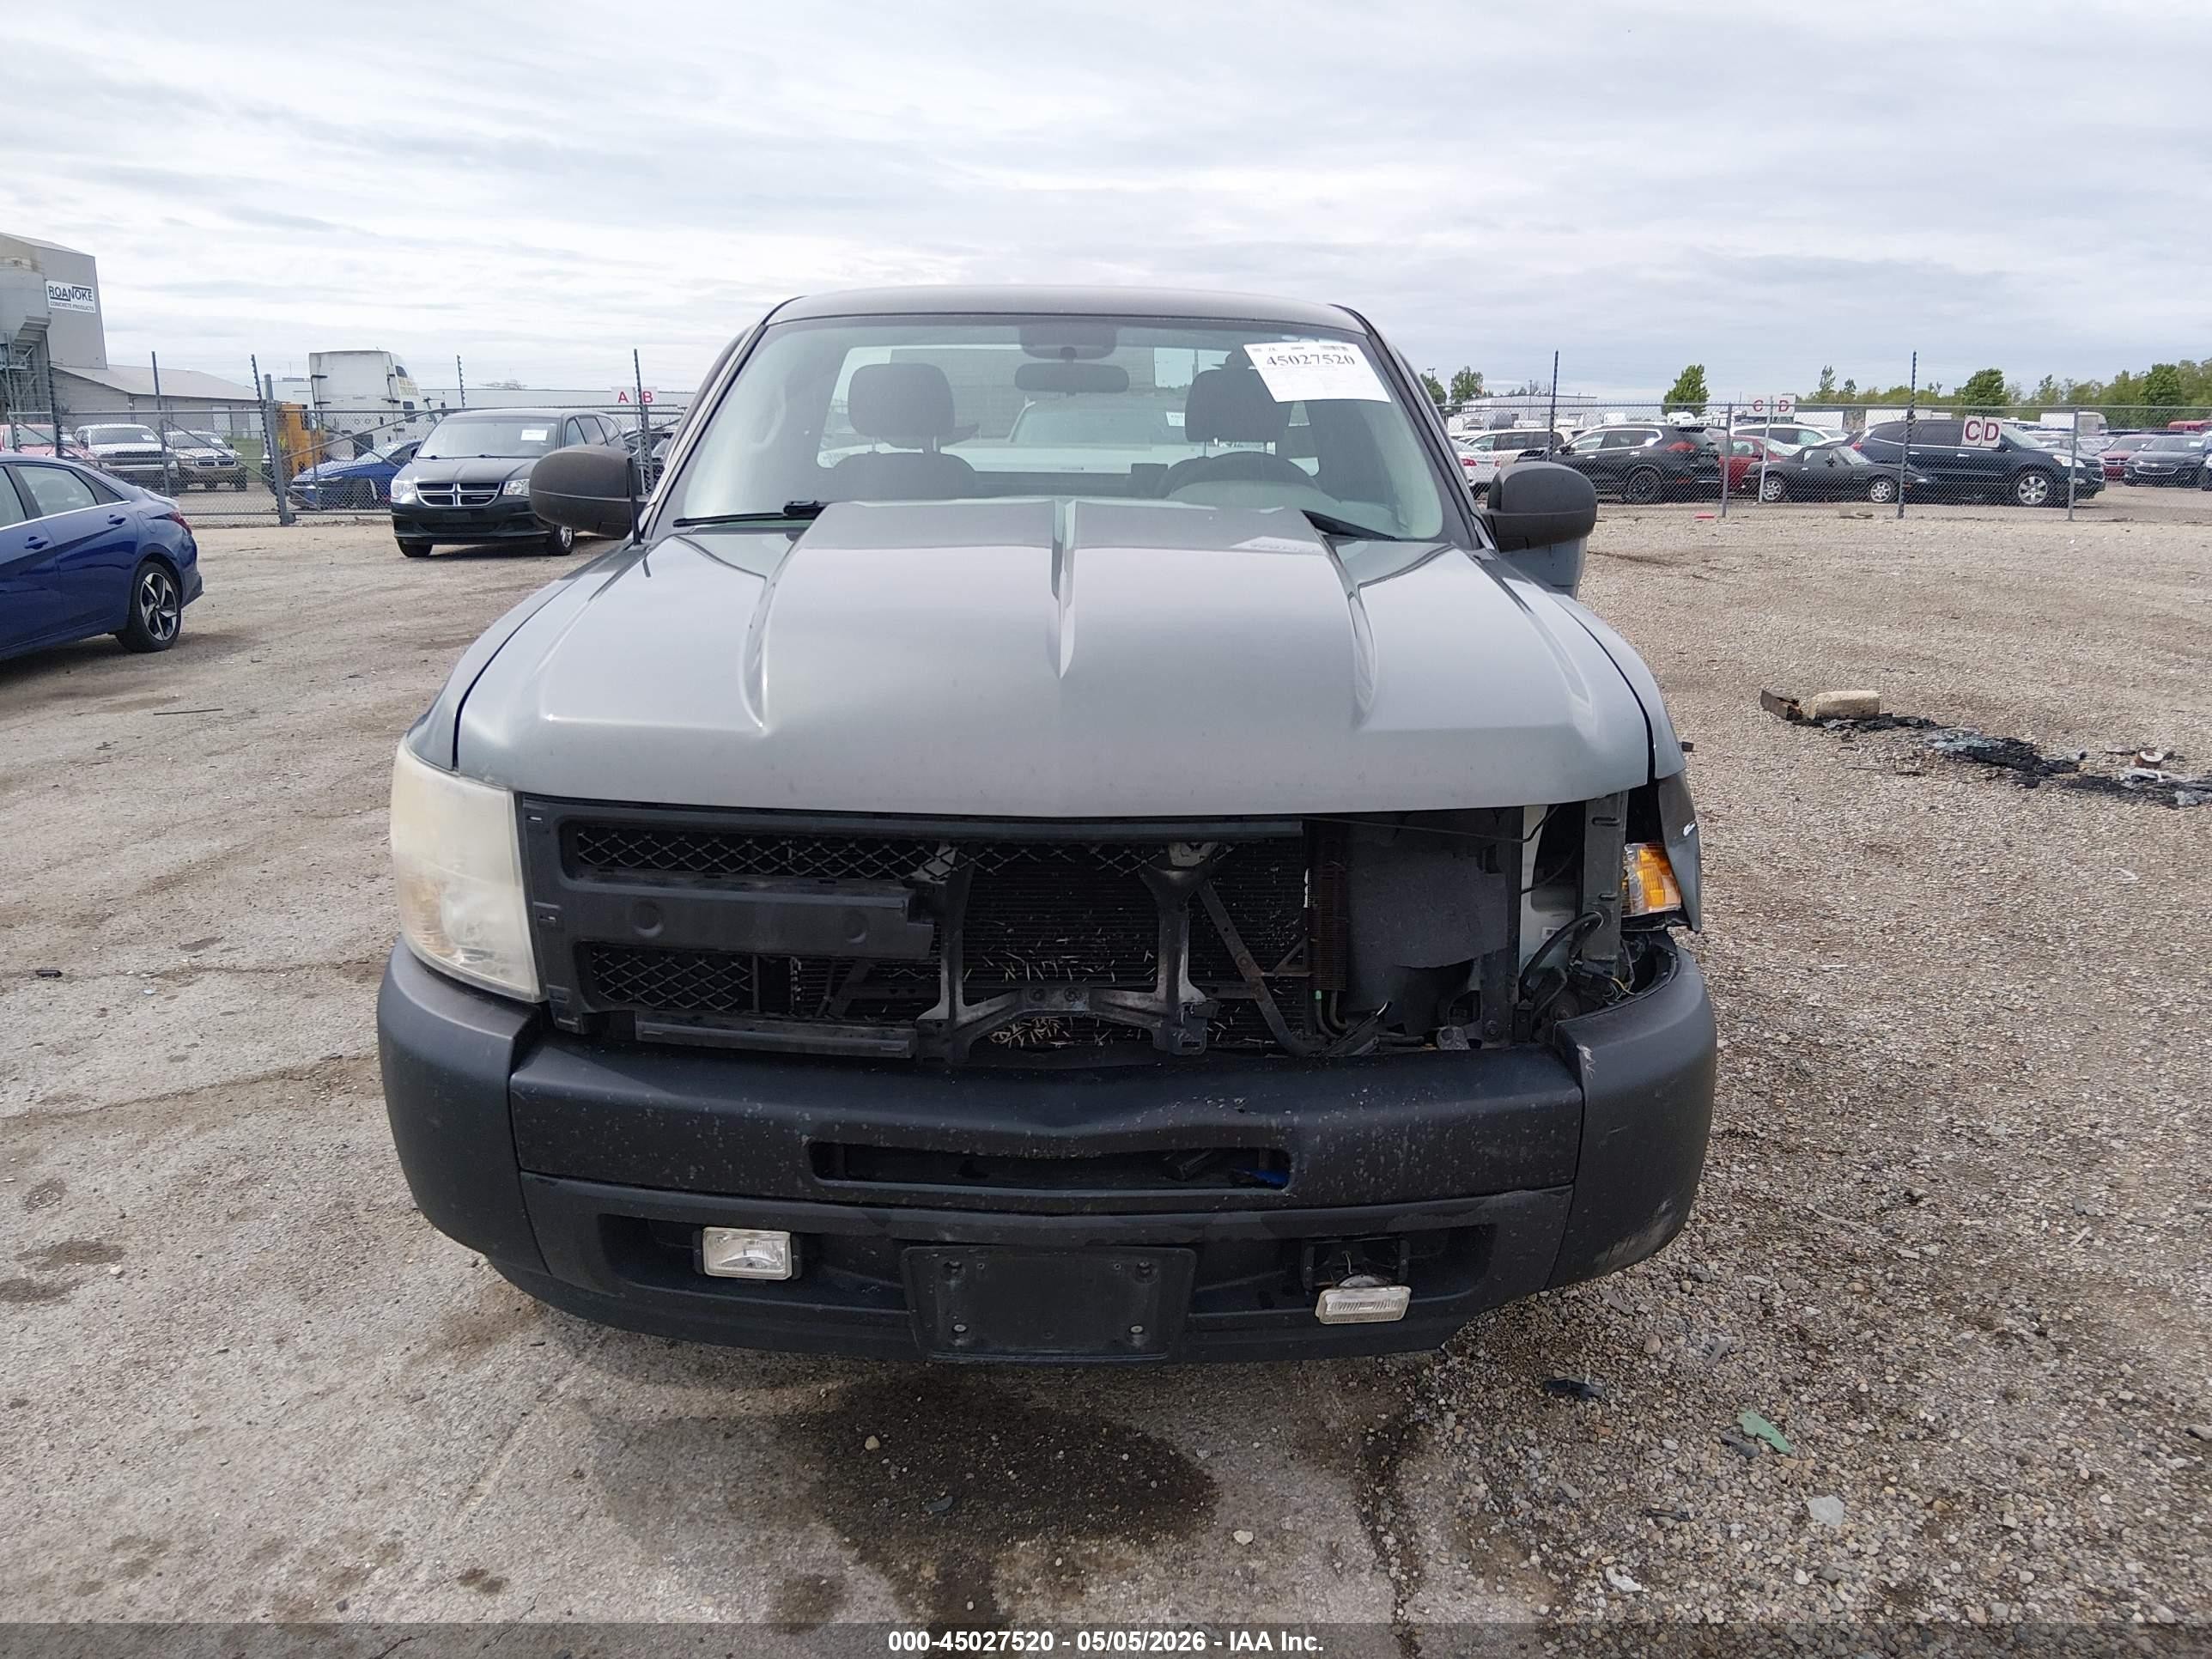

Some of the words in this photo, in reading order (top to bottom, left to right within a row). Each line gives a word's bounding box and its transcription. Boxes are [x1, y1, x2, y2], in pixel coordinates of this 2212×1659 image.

[48, 286, 94, 301] ROANOKE
[1267, 354, 1356, 366] 45027520
[617, 391, 629, 404] A
[642, 391, 653, 404] B
